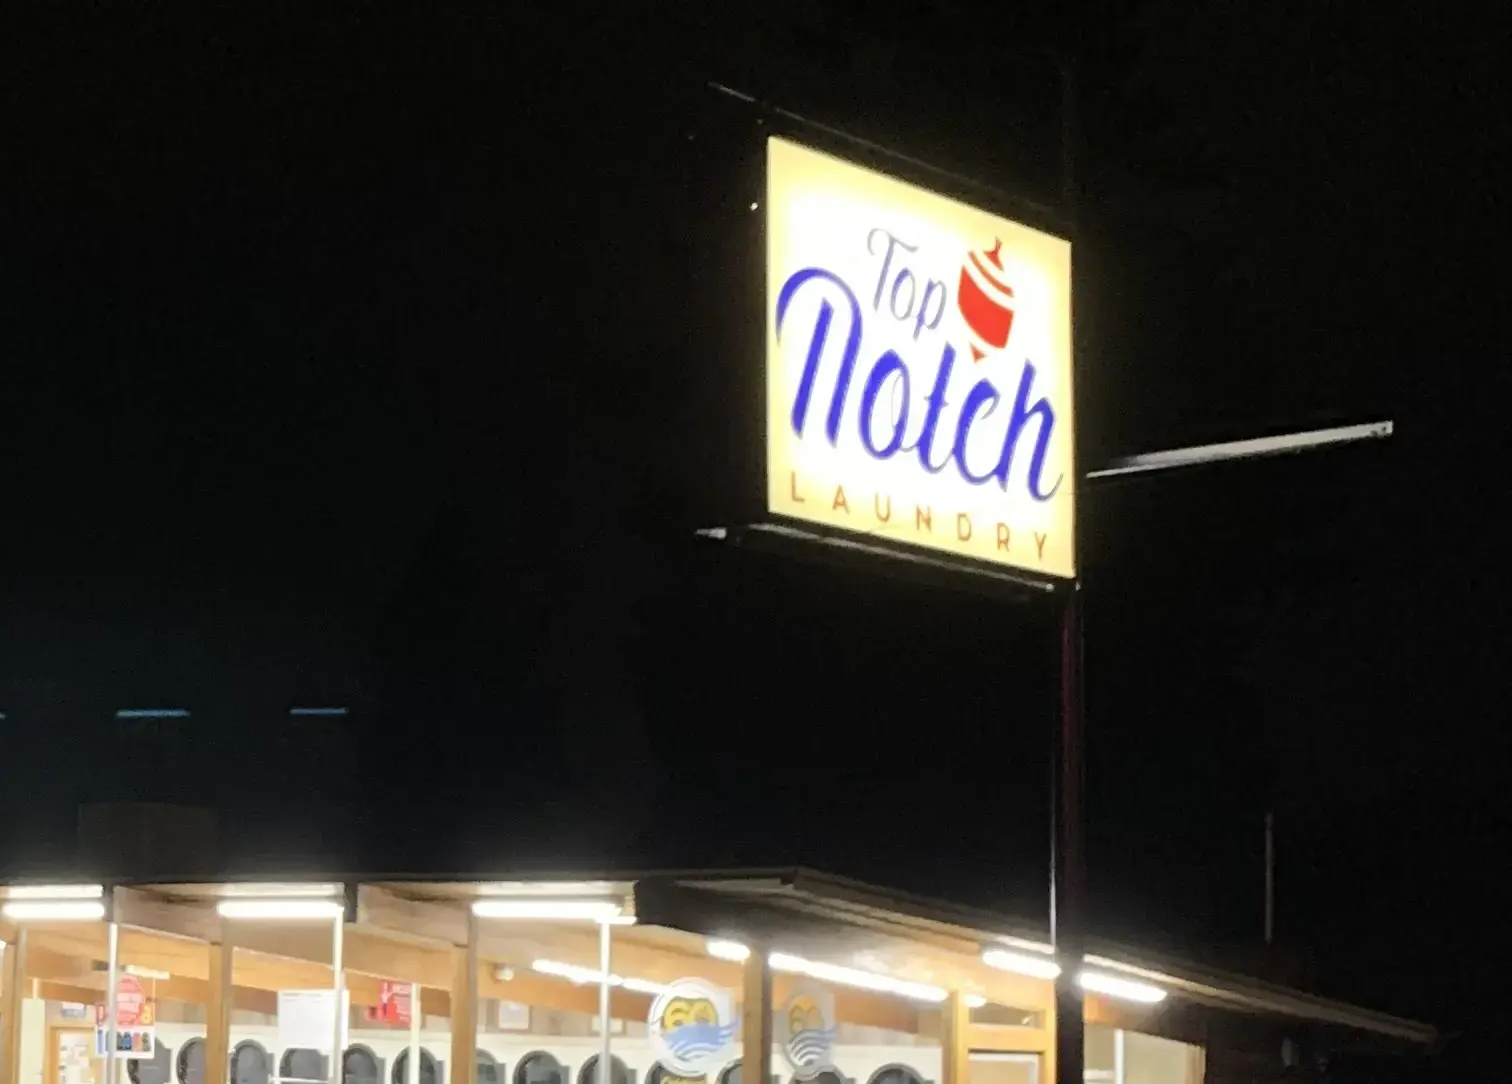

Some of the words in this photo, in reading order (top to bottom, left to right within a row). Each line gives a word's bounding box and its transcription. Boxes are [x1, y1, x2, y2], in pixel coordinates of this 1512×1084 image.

[867, 228, 947, 340] Top
[776, 266, 1064, 501] Notch
[791, 471, 1047, 559] LAUNDRY
